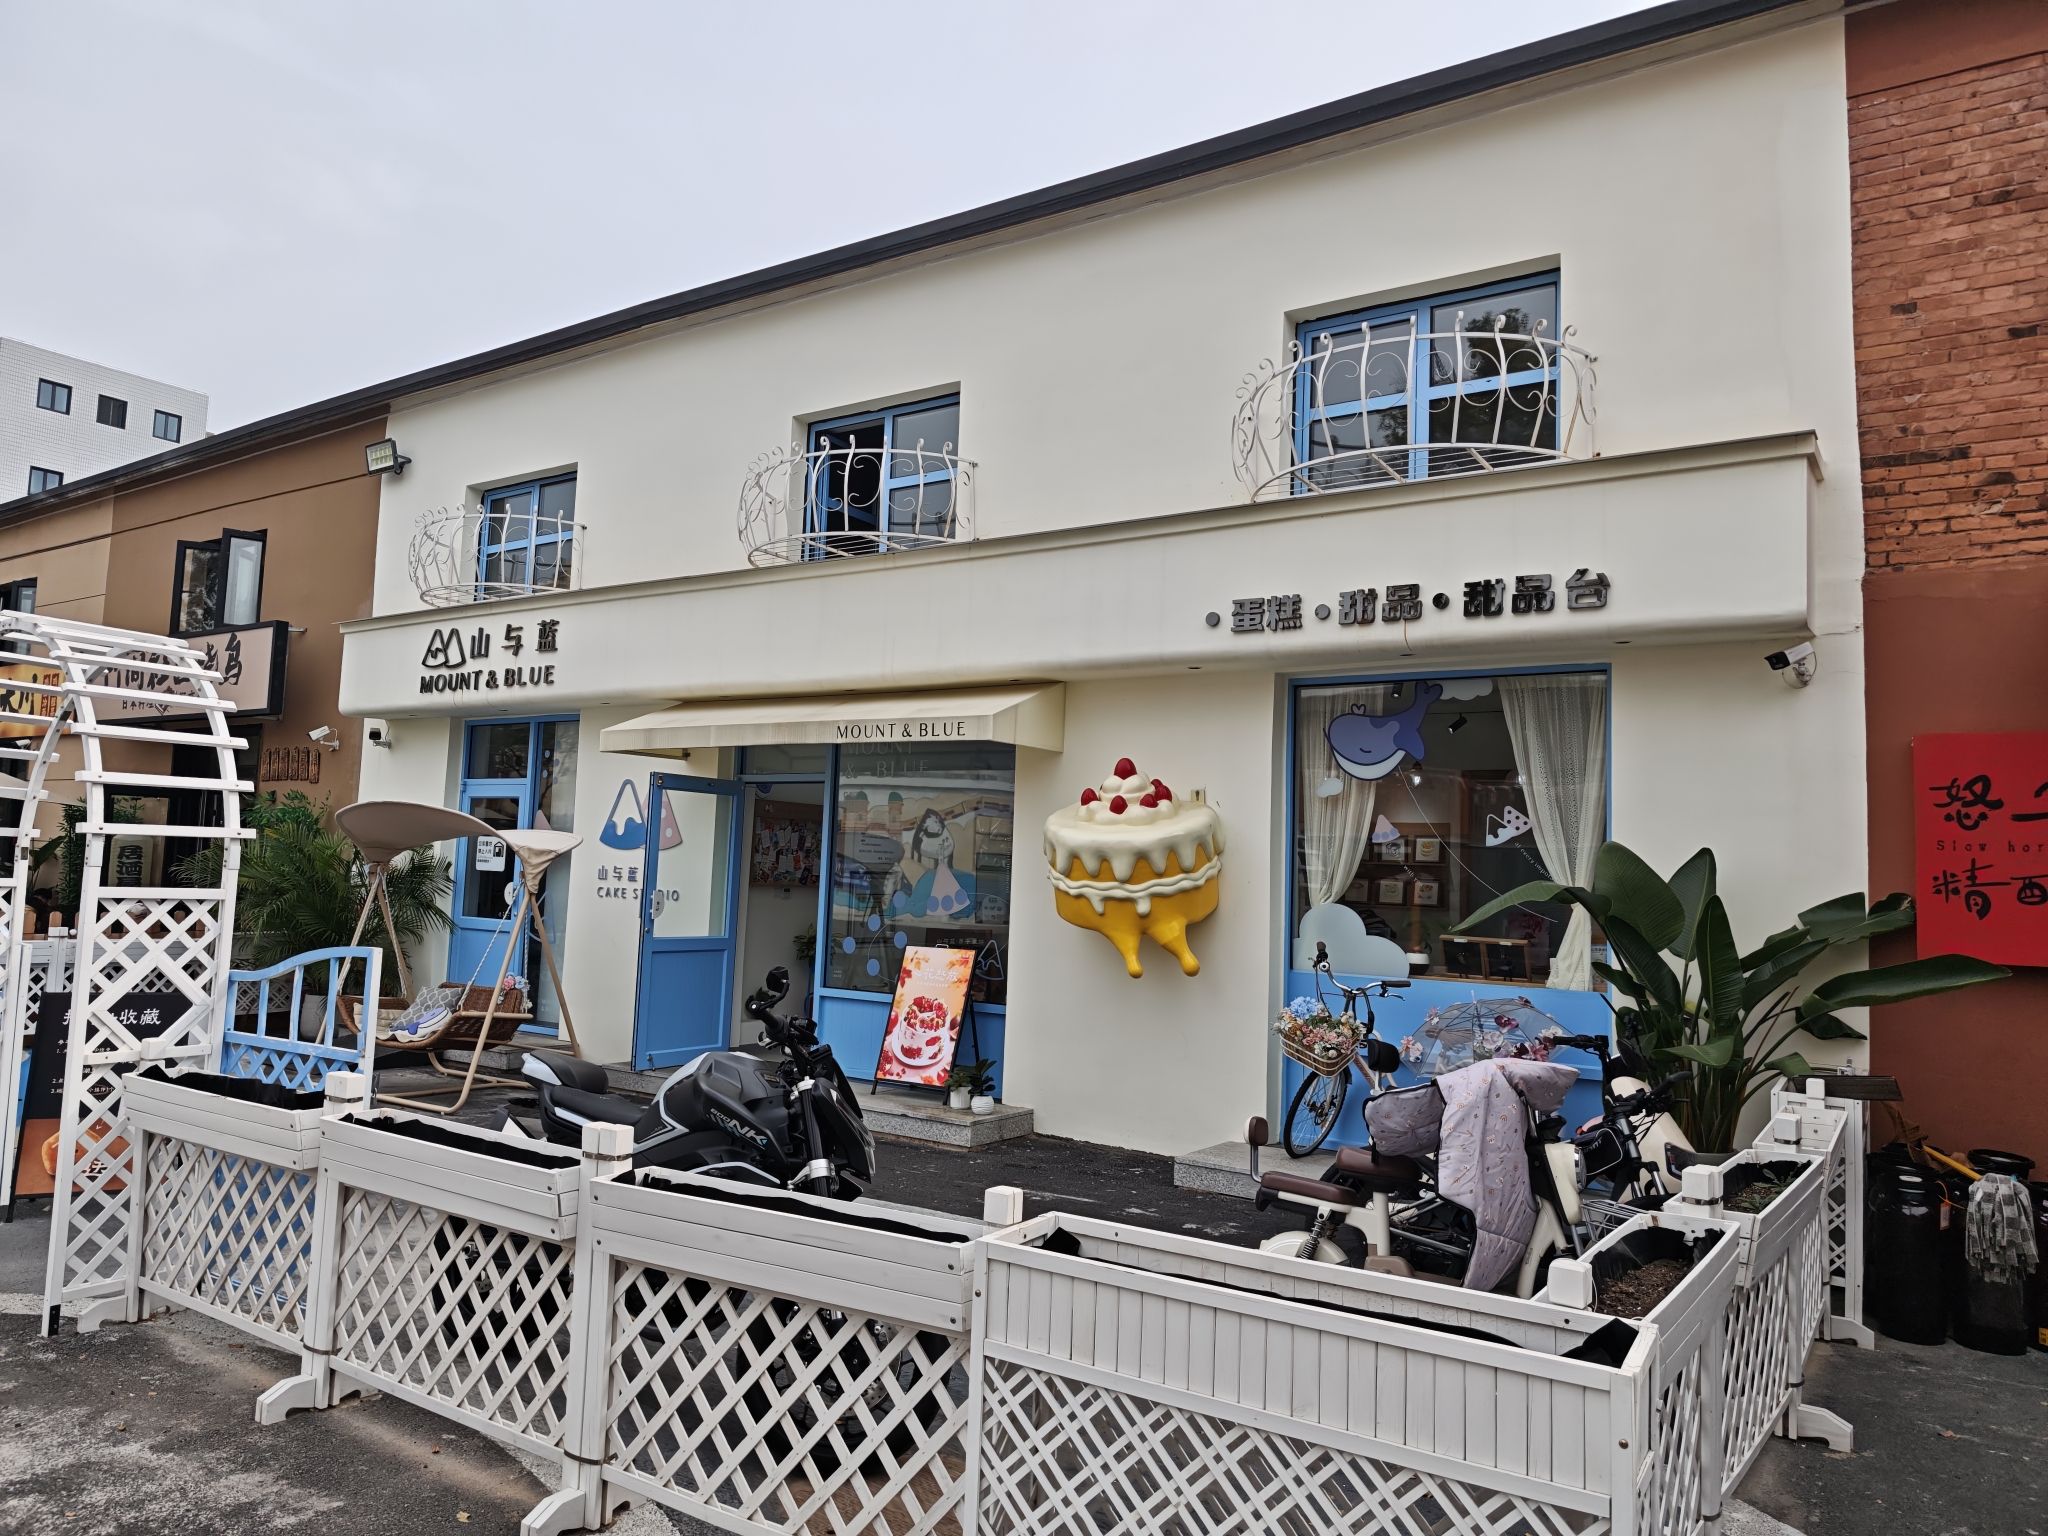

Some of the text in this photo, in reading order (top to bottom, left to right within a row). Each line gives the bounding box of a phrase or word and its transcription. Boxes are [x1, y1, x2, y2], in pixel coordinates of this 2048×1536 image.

[470, 619, 560, 659] 山与蓝
[420, 665, 555, 693] MOUNT & BLUE
[836, 721, 966, 739] MOUNT & BLUE
[1936, 840, 1987, 851] Slow
[597, 865, 639, 882] 山与蓝
[597, 886, 627, 899] CAKE
